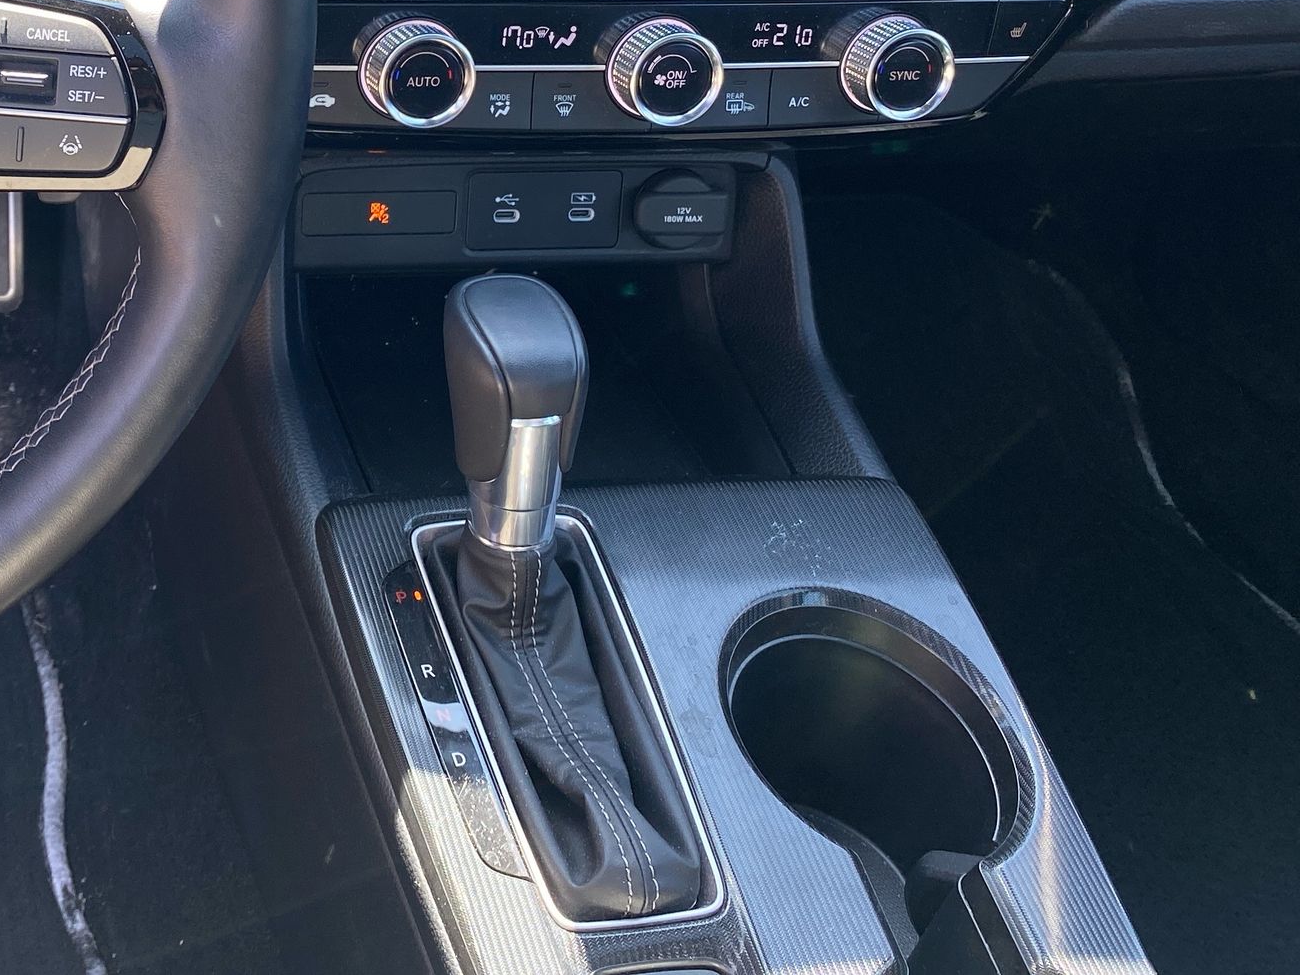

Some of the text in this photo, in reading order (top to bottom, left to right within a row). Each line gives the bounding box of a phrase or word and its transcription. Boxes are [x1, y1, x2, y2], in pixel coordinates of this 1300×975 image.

[754, 22, 770, 32] A/C
[26, 28, 70, 43] CANCEL
[752, 38, 769, 47] OFF
[69, 65, 107, 79] RES/+
[889, 70, 920, 81] SYNC
[407, 76, 440, 87] AUTO
[666, 80, 686, 88] OFF
[490, 94, 511, 102] MODE
[553, 94, 577, 102] FRONT
[726, 92, 745, 100] REAR
[789, 97, 810, 107] A/C
[677, 207, 691, 215] 12V
[664, 215, 703, 223] 180W MAX
[395, 591, 407, 603] P
[421, 664, 436, 678] R
[452, 752, 466, 767] D
